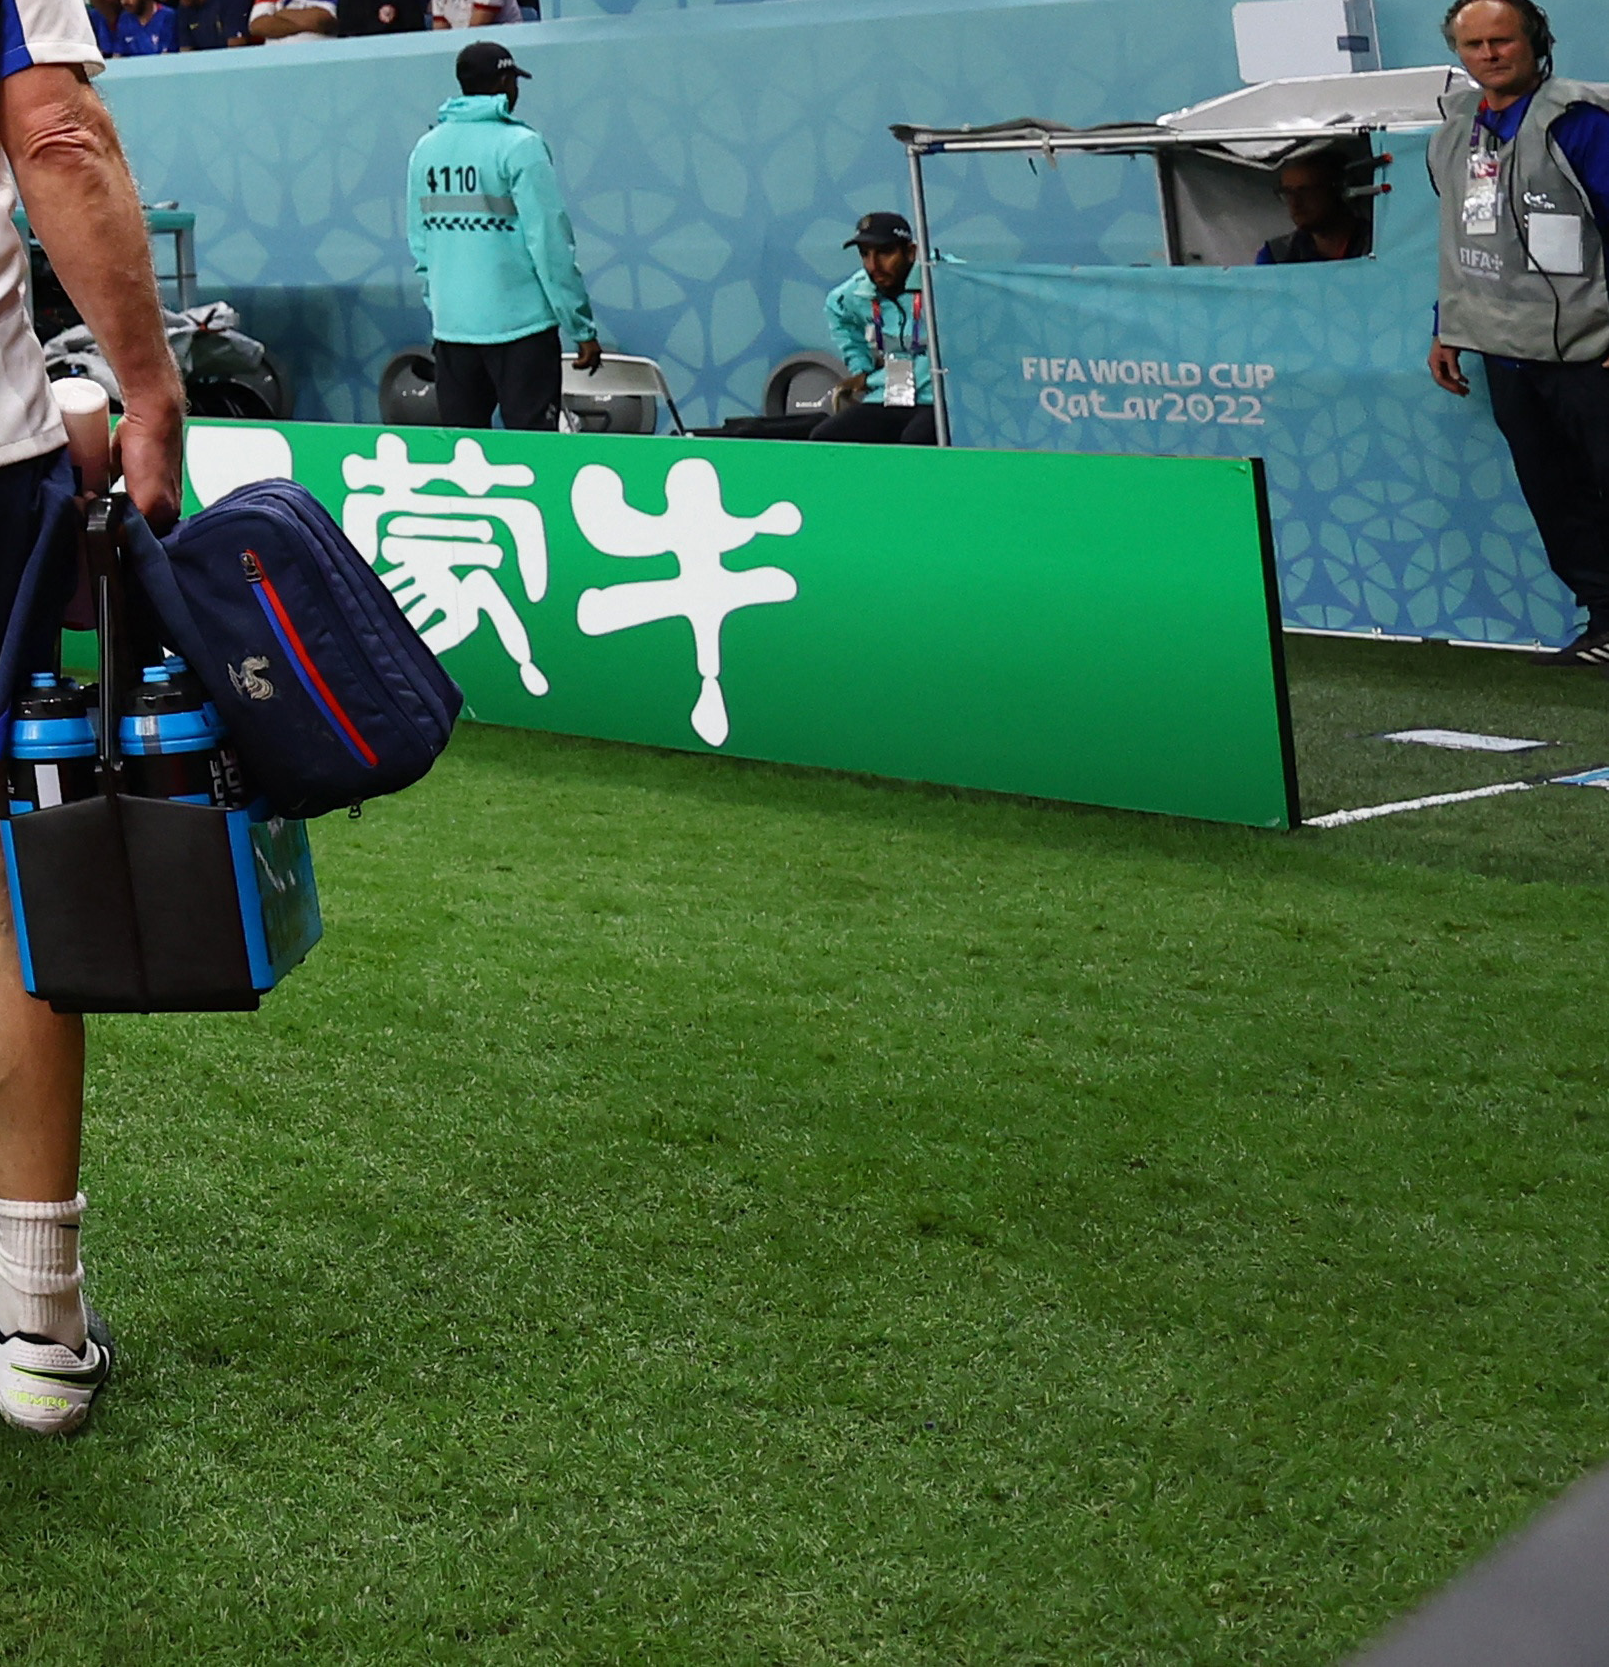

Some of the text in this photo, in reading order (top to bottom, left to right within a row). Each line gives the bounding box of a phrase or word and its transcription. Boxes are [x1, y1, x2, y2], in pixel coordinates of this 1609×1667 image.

[426, 165, 477, 193] 4110
[1022, 356, 1275, 389] FIFA WORLD CUP
[340, 431, 805, 748] 蒙牛
